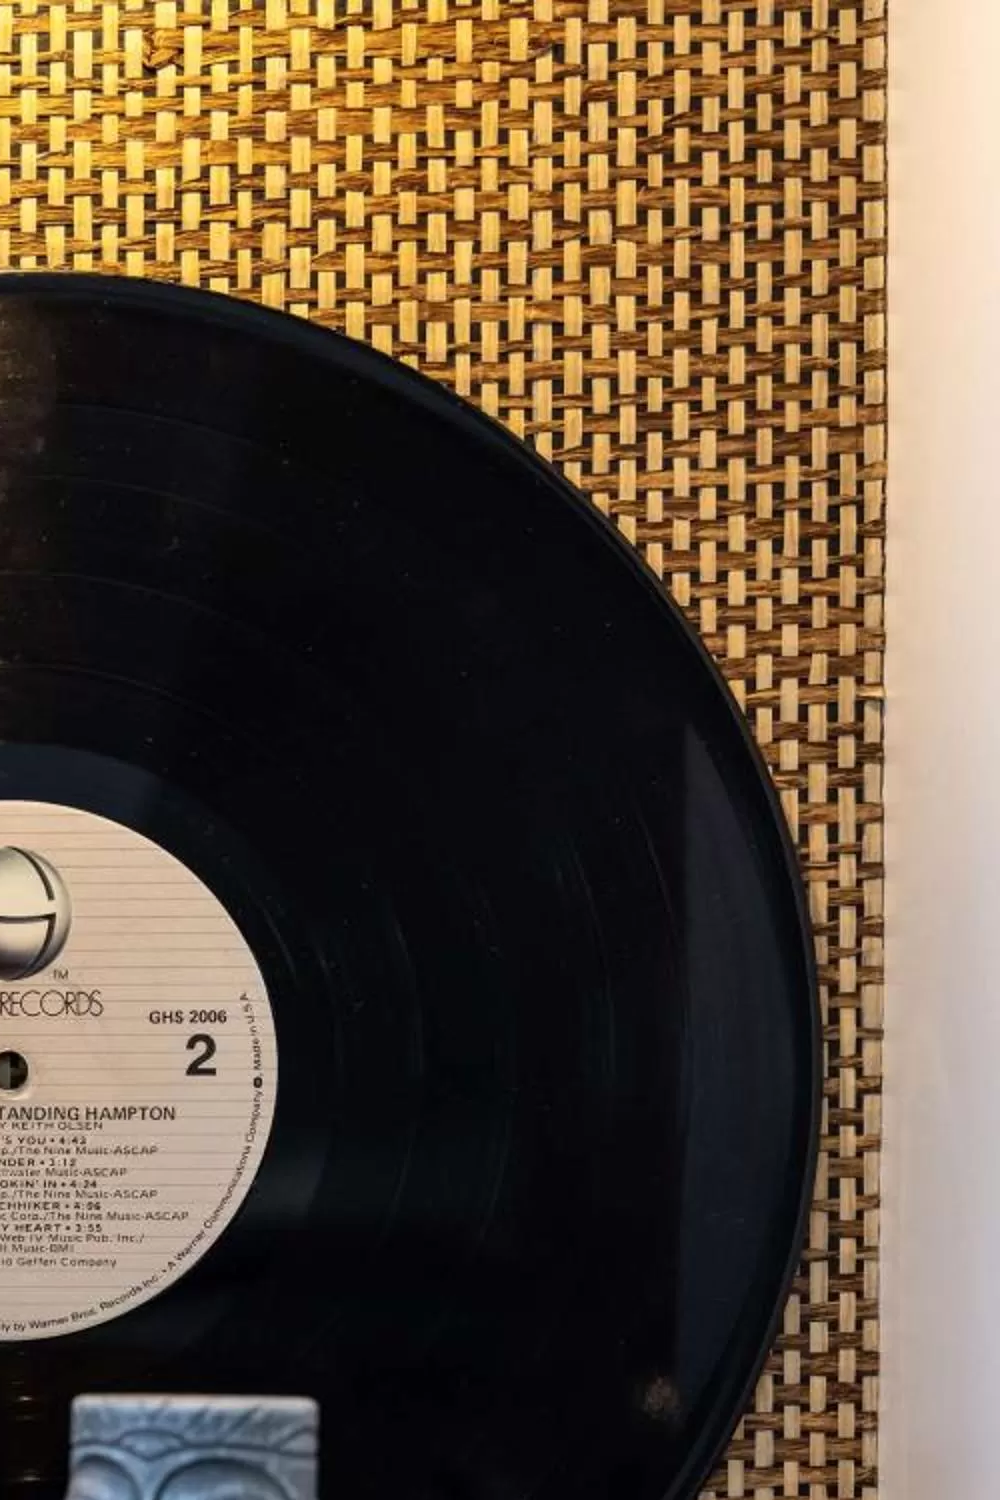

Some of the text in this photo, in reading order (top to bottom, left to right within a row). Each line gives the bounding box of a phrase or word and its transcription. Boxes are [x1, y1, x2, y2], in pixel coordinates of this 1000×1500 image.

[0, 989, 105, 1018] RECORDS
[149, 1009, 228, 1025] GHS 2006
[185, 1032, 217, 1077] 2
[85, 1105, 176, 1121] HAMPTON
[11, 1121, 54, 1131] KEITH
[57, 1121, 104, 1131] OLSEN
[17, 1135, 47, 1145] YOU
[43, 1179, 58, 1189] IN
[15, 1223, 62, 1233] HEART
